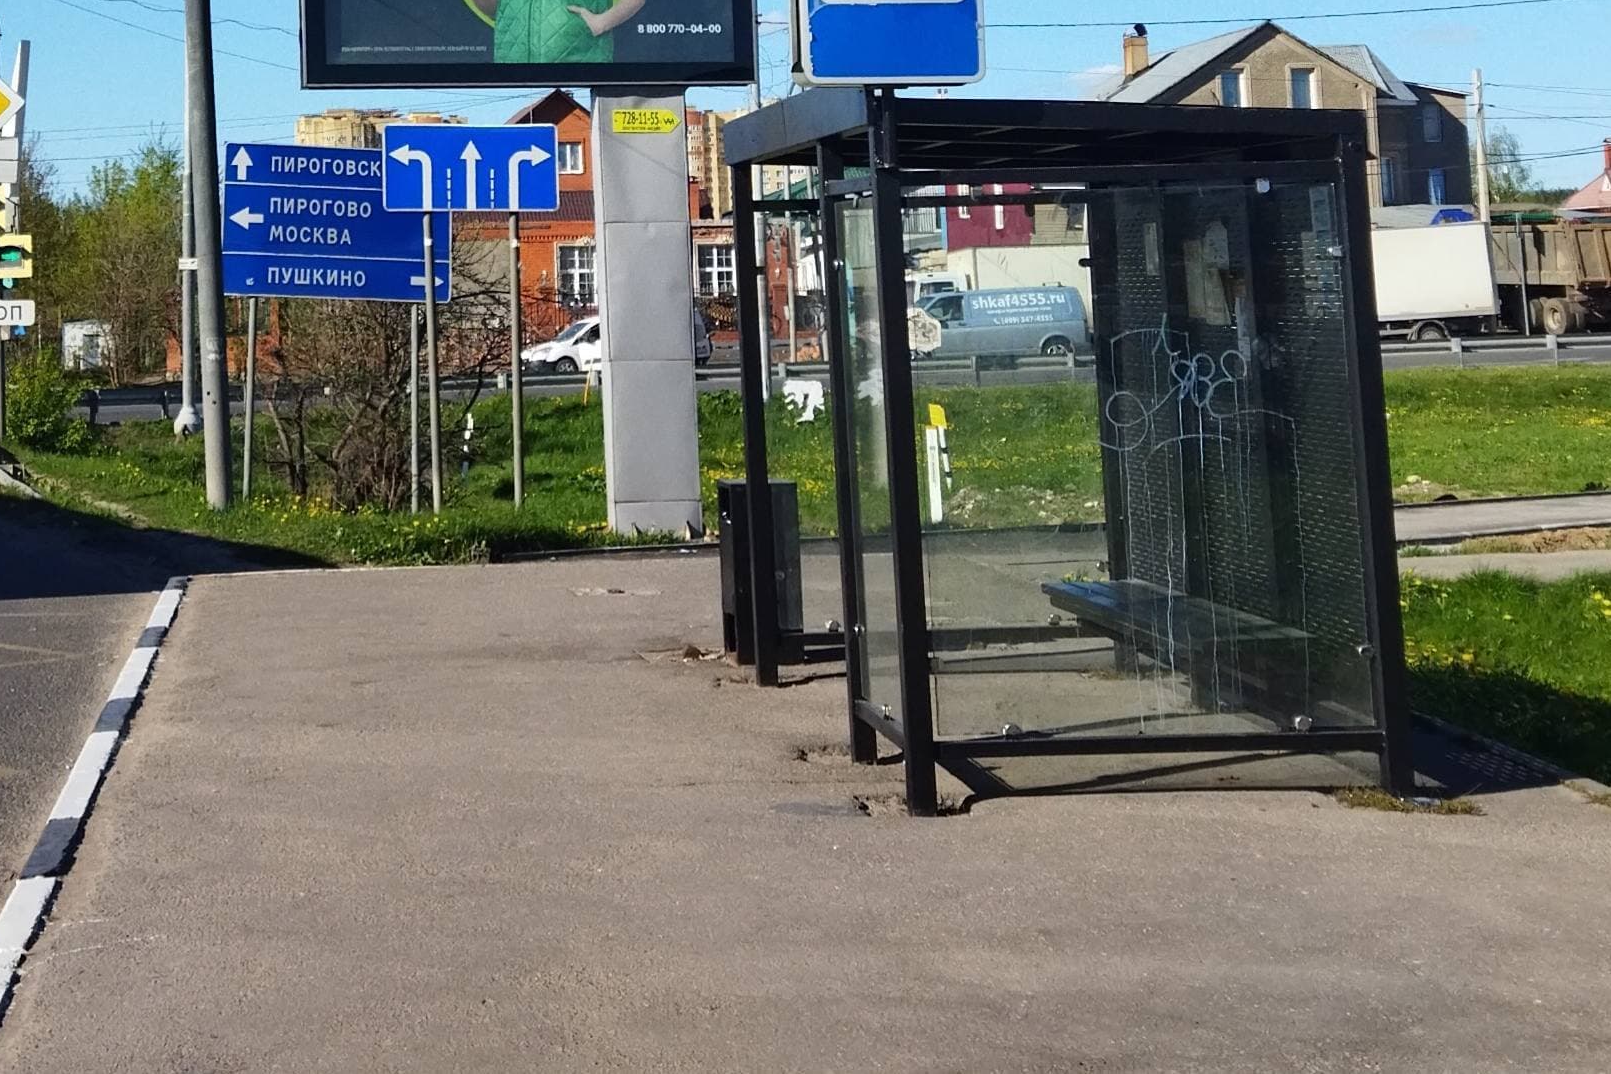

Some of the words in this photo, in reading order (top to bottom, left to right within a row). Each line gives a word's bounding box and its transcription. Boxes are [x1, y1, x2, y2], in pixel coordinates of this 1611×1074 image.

[637, 24, 645, 34] 8
[646, 24, 666, 34] 800
[271, 155, 382, 177] ПИРОГОВСК
[270, 197, 372, 218] ПИРОГОВО
[269, 225, 352, 245] МОСКВА
[267, 266, 367, 287] ПУШКИНО
[972, 293, 1066, 310] shkaf4555.ru
